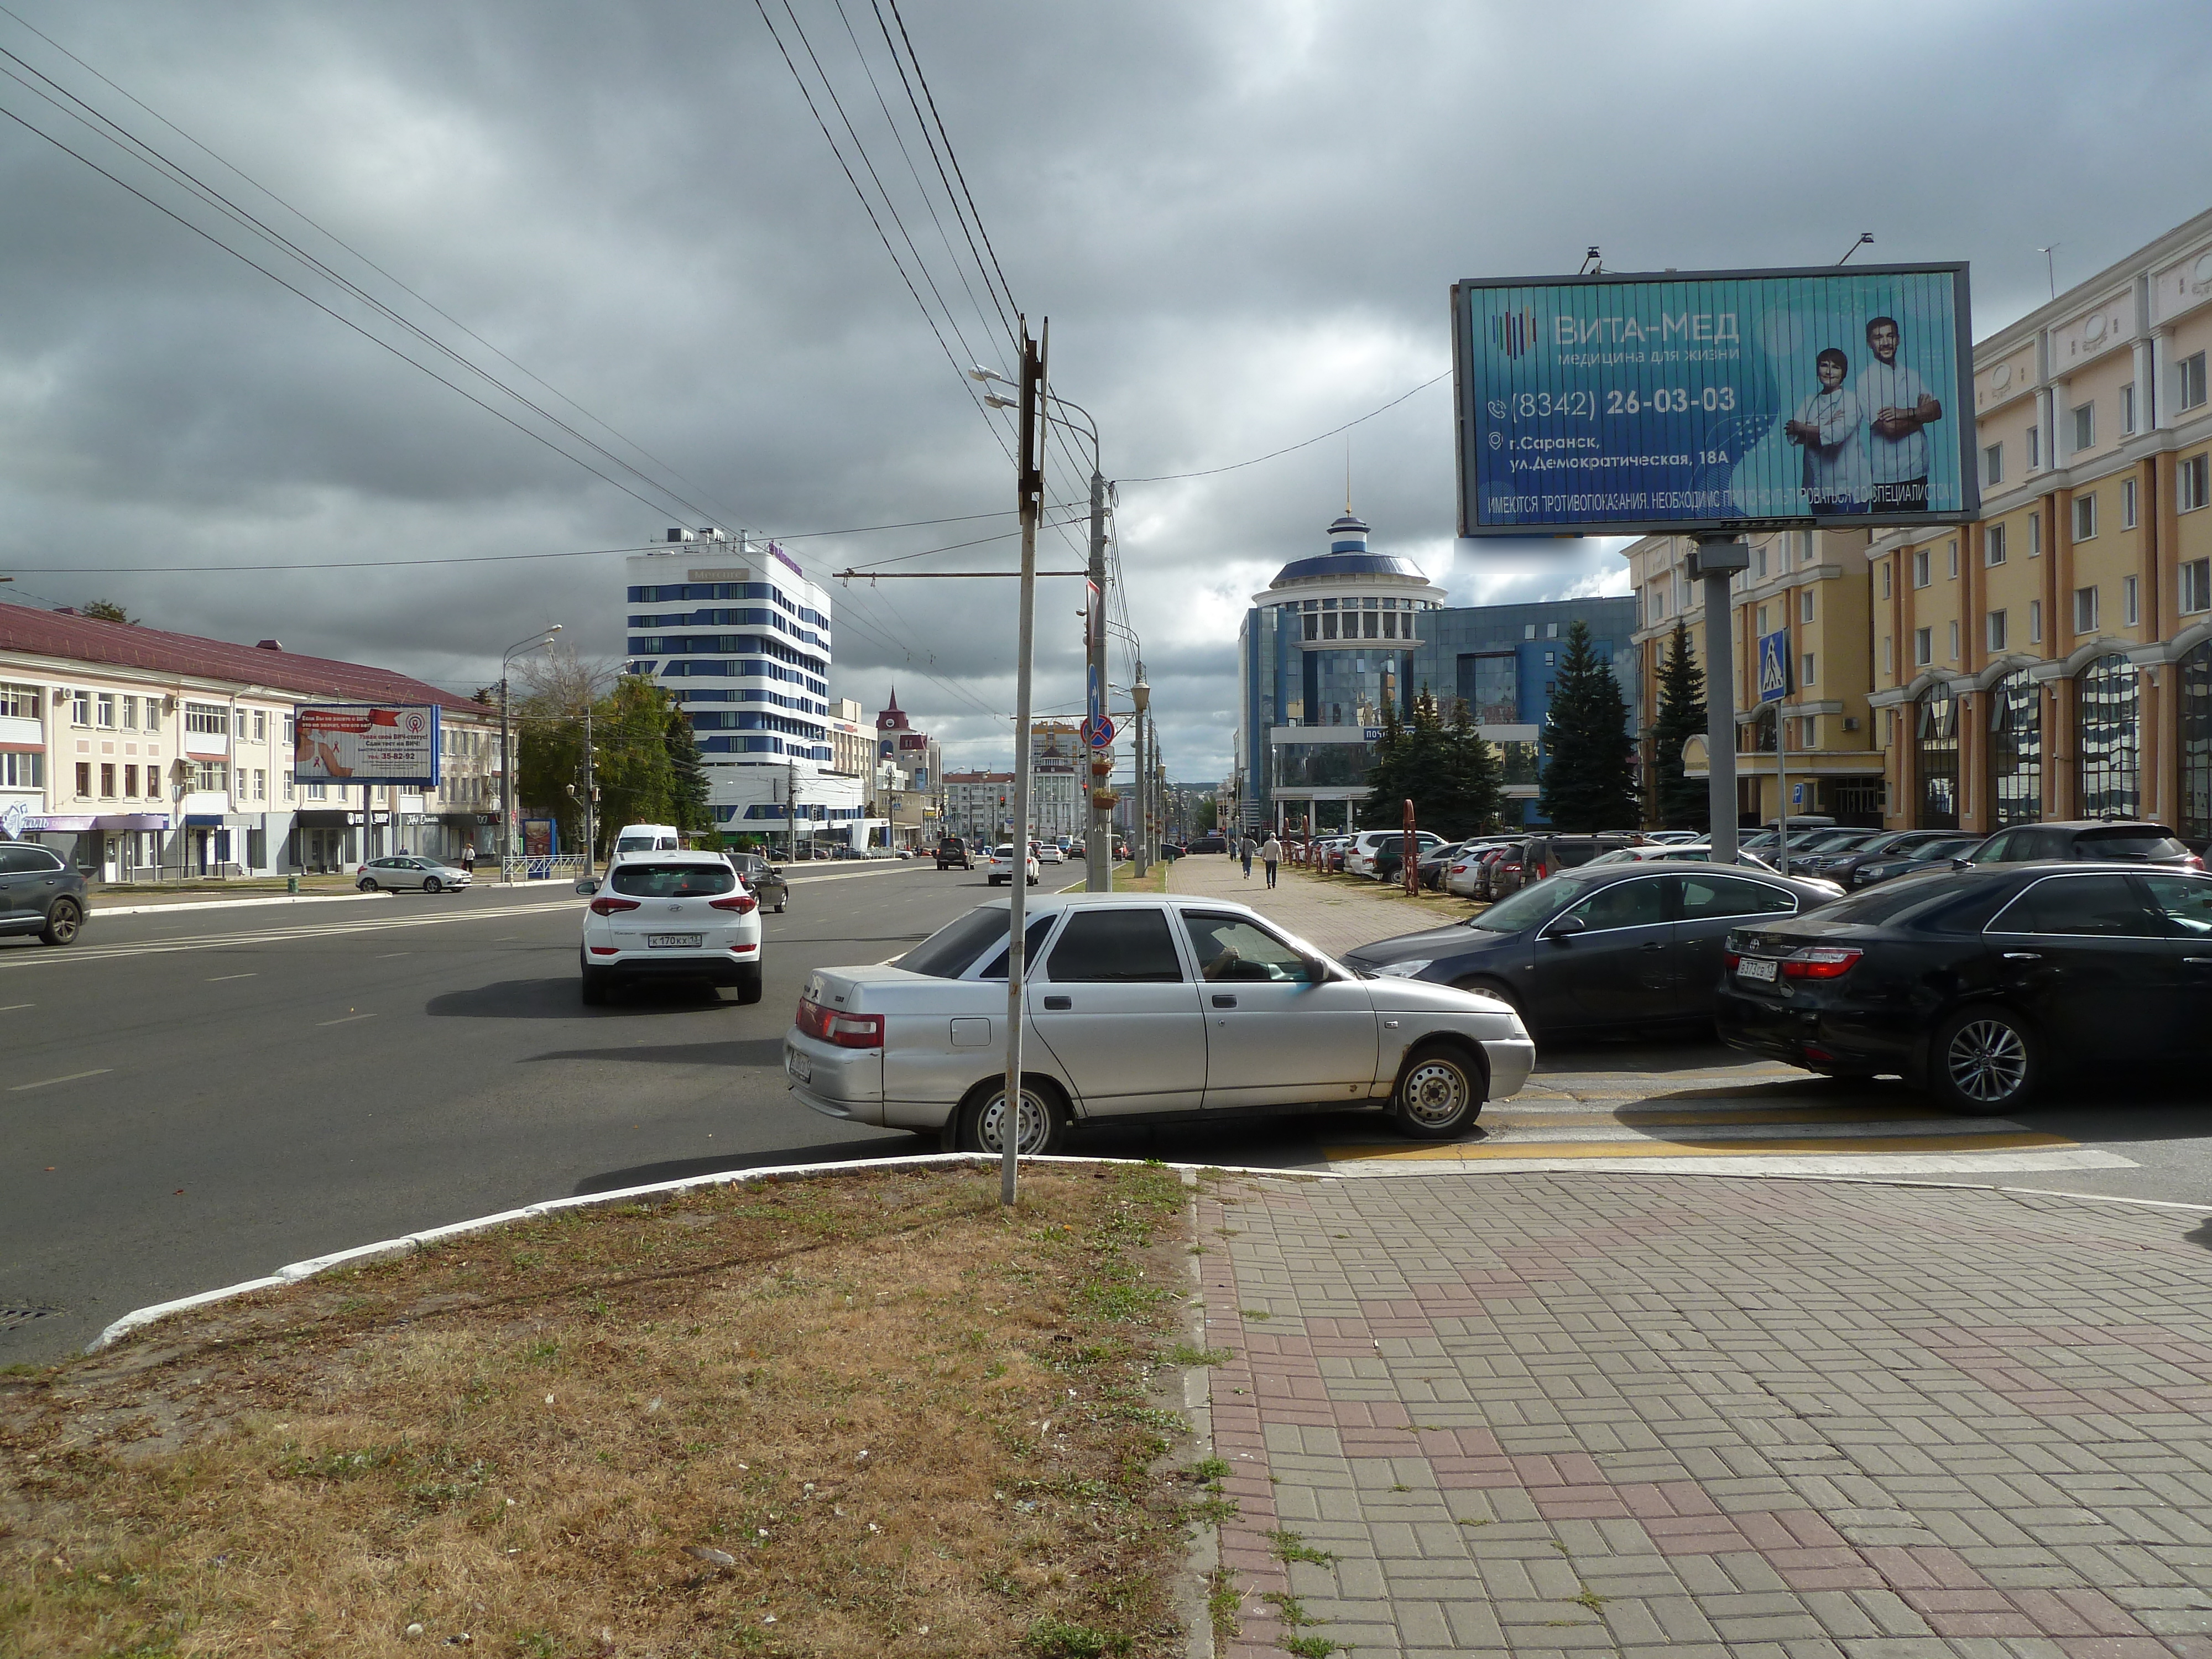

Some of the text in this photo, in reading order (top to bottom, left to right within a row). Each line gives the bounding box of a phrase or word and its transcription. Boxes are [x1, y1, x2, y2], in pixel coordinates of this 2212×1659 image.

[1555, 312, 1740, 345] ВИТА-МЕД
[1558, 348, 1740, 368] медицина для жизни
[1512, 387, 1735, 423] (8342) 26-03-03
[1509, 436, 1600, 452] г.Саранск,
[1510, 450, 1729, 473] ул.Демократическая, 18А
[1488, 495, 1538, 514] ИМЕЮТСЯ
[695, 570, 742, 579] Mercure
[1794, 786, 1800, 801] P
